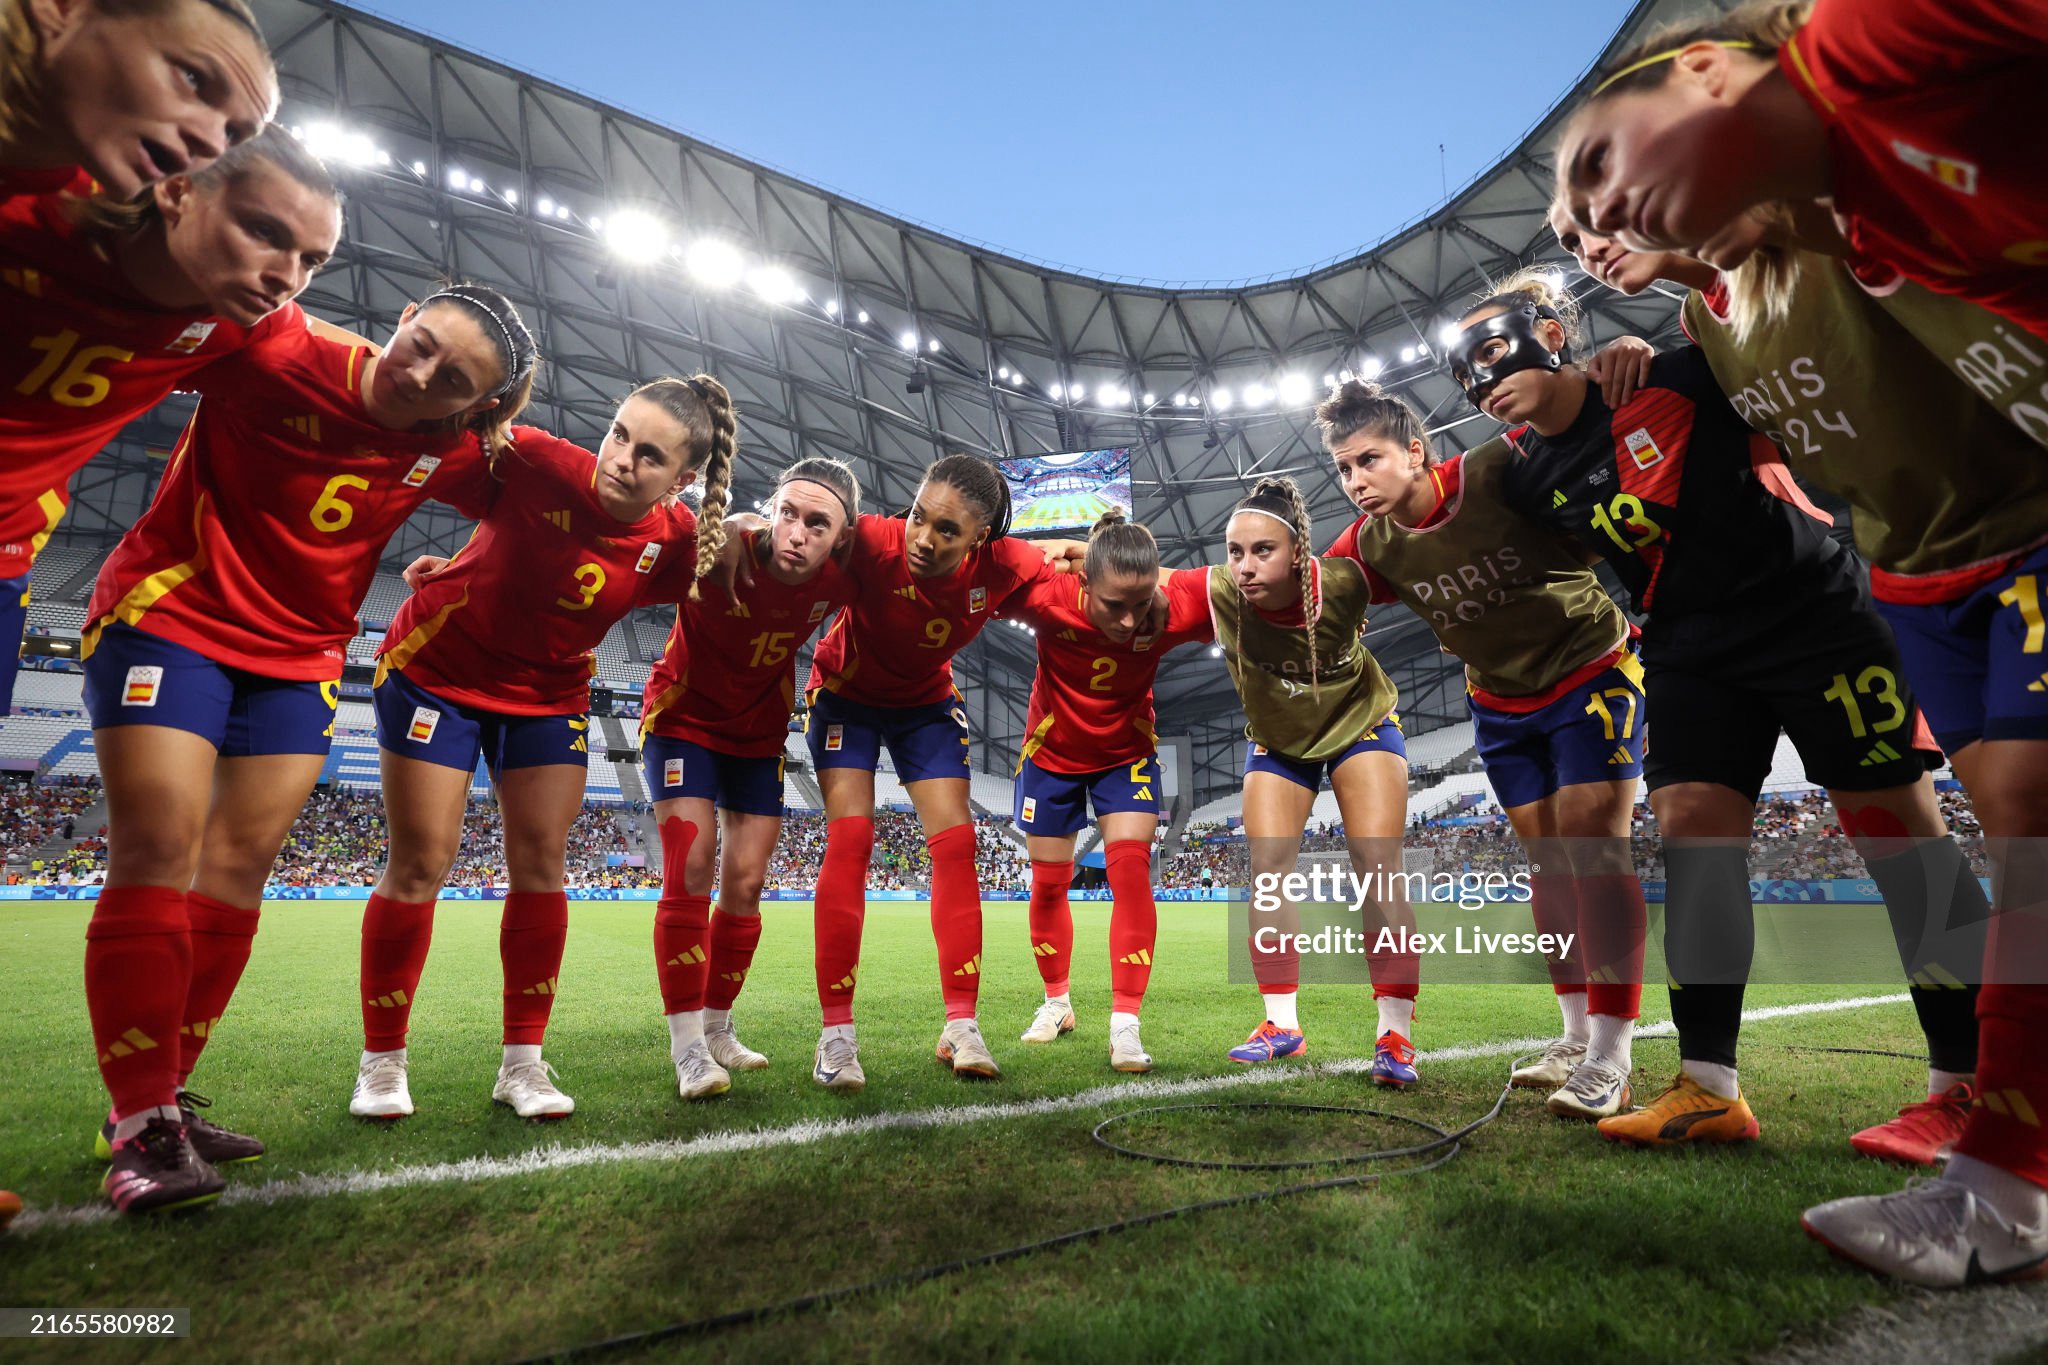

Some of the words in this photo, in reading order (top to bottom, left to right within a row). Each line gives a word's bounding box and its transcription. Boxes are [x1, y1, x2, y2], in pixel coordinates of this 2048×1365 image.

[15, 327, 134, 407] 16
[309, 474, 370, 532] 6
[1590, 492, 1661, 553] 13
[556, 562, 606, 611] 3
[749, 632, 795, 668] 15
[918, 618, 951, 649] 9
[1089, 656, 1118, 691] 2
[1585, 687, 1637, 740] 17
[1824, 665, 1907, 738] 13
